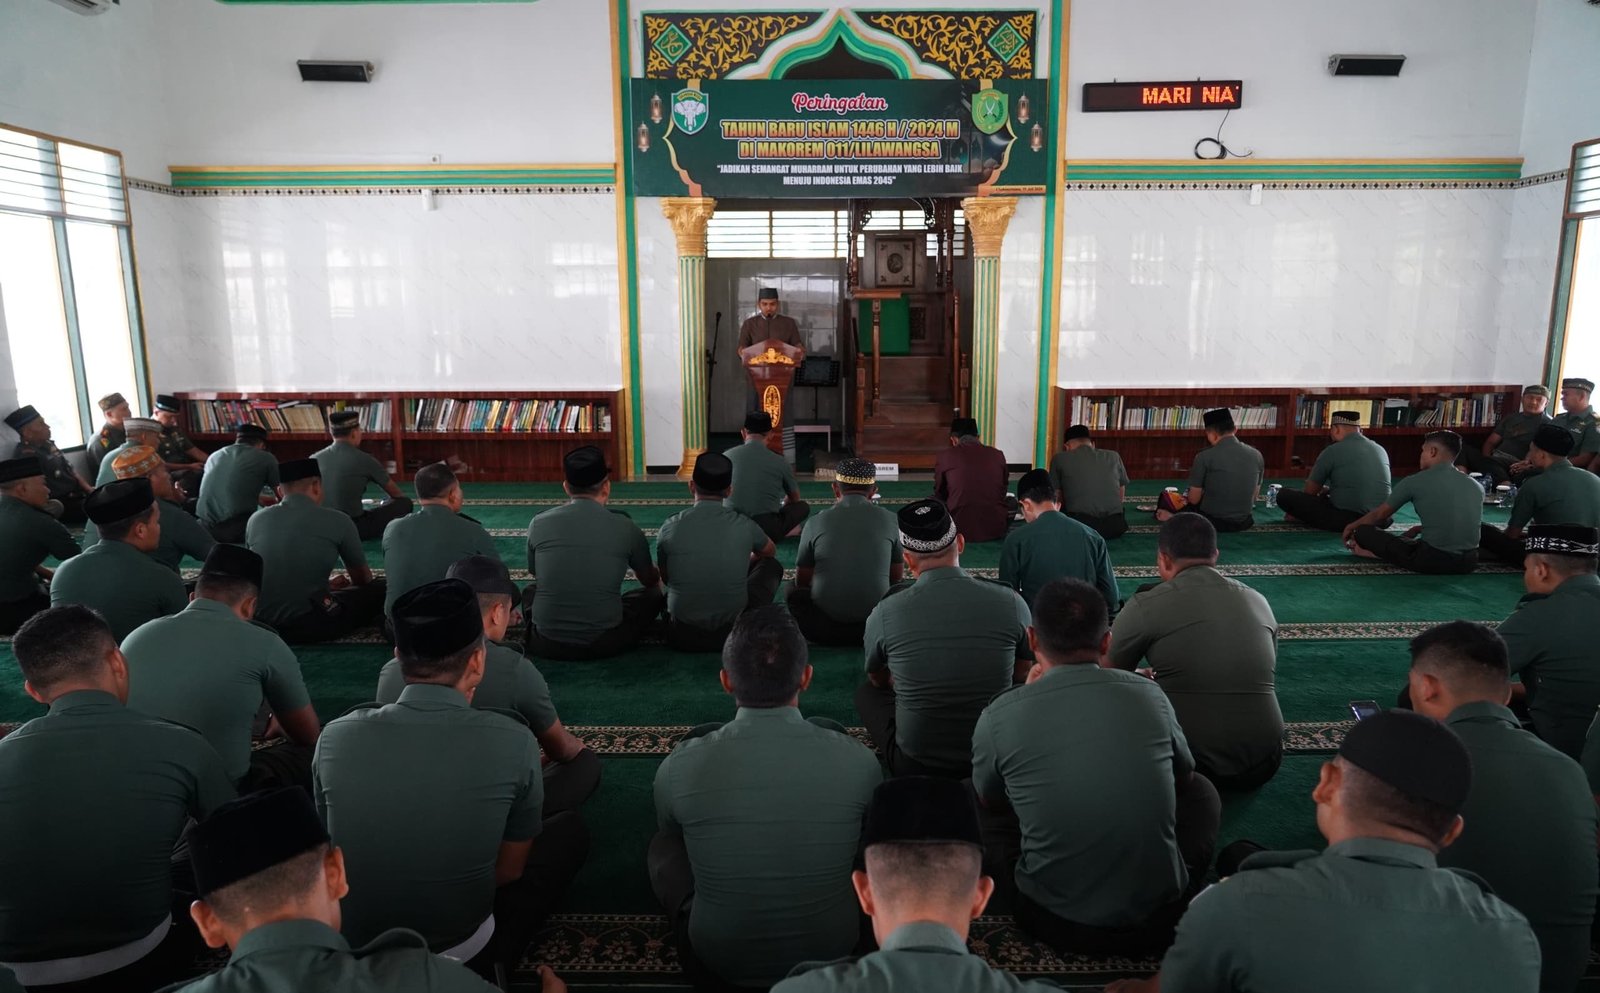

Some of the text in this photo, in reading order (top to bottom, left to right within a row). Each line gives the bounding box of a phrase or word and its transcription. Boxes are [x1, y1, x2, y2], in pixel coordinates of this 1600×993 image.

[1142, 86, 1235, 104] MARI NIA
[793, 93, 888, 114] Peringatan
[722, 121, 959, 137] TAHUN BARU ISLAM 1446 H / 2024 M
[740, 141, 940, 158] DI MAKOREM 011/LILAWANGSA
[752, 165, 789, 174] SEMANGAT
[791, 165, 833, 174] MUHARRAM
[834, 165, 858, 174] UNTUK
[860, 165, 901, 174] PERUBAHAN
[903, 165, 922, 174] YANG
[924, 165, 944, 174] LEBIH
[945, 165, 962, 174] BAIK
[783, 176, 812, 185] MENUJU
[813, 176, 851, 185] INDONESIA
[852, 176, 872, 185] EMAS
